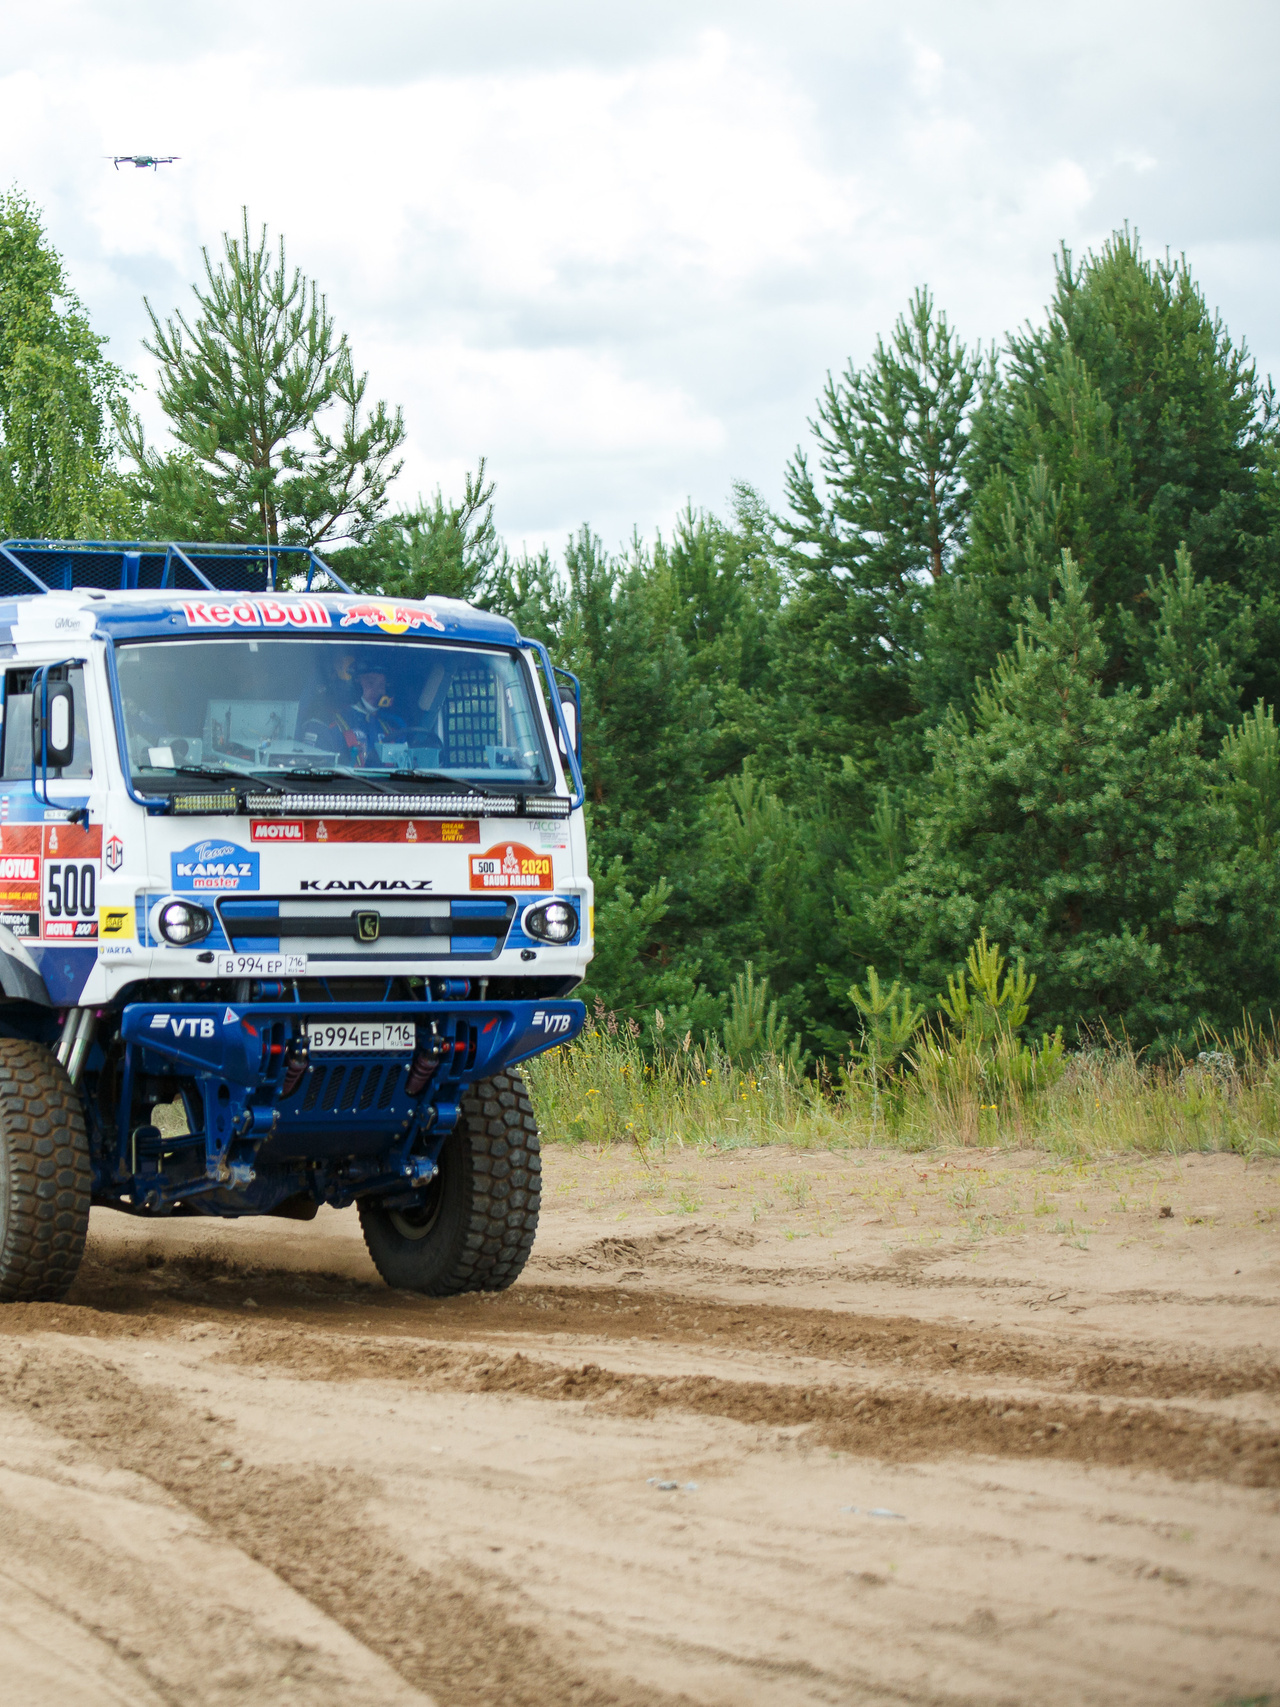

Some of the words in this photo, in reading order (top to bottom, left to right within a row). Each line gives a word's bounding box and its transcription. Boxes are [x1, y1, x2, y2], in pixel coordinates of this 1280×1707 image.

[182, 600, 260, 626] Red
[257, 600, 332, 627] Bull
[255, 824, 302, 838] MOTUL
[195, 841, 235, 862] Team
[176, 863, 252, 876] KAMAZ
[478, 861, 494, 873] 500
[521, 859, 549, 874] 2020
[193, 876, 239, 888] master
[300, 880, 433, 891] KAMAZ
[483, 875, 508, 886] SAUDI
[509, 875, 540, 886] ARABIA
[48, 864, 96, 917] 500
[12, 925, 30, 936] sport
[46, 923, 74, 936] MOTUL
[106, 946, 133, 954] VARTA
[237, 958, 264, 973] 994
[288, 956, 303, 967] 716
[170, 1018, 215, 1038] VTB
[544, 1014, 571, 1033] VTB
[385, 1025, 411, 1041] 716
